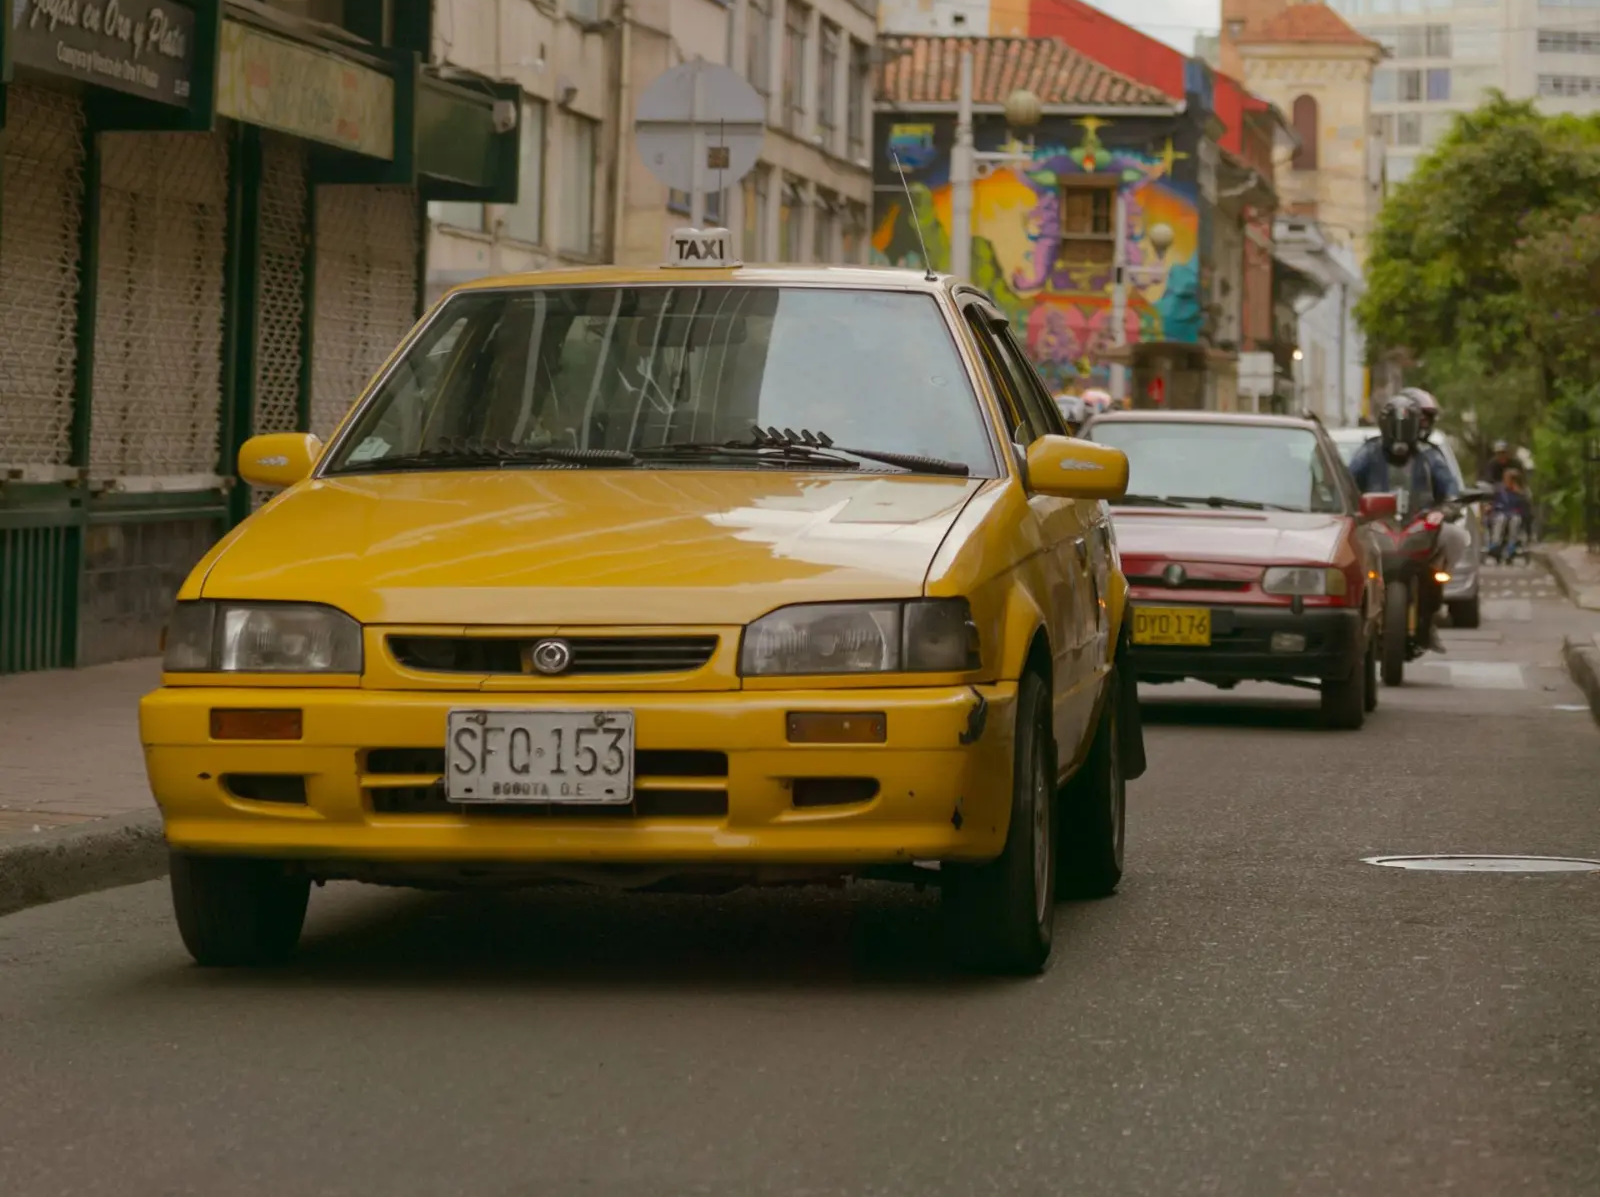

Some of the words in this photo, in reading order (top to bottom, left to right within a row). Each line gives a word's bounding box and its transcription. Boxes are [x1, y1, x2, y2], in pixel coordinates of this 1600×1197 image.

[83, 2, 100, 32] en
[134, 20, 144, 60] y
[145, 7, 186, 59] Plata
[675, 239, 724, 260] TAXI
